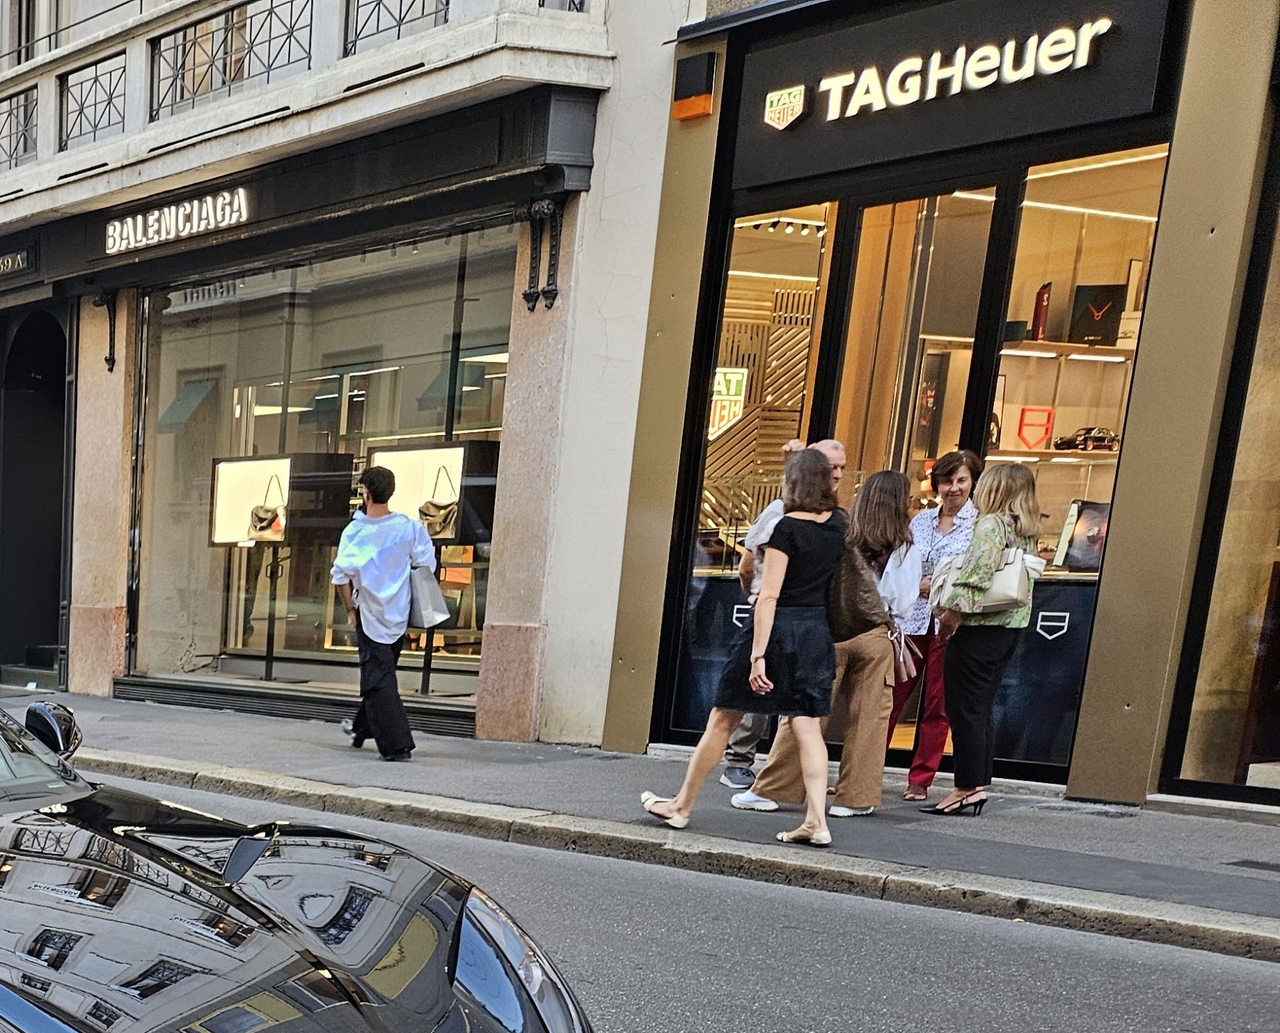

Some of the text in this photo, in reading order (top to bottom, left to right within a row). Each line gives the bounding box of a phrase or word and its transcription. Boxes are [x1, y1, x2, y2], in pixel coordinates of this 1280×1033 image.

[769, 90, 801, 108] TAG
[768, 104, 801, 127] HEUER
[105, 187, 247, 254] BALENCIAGA
